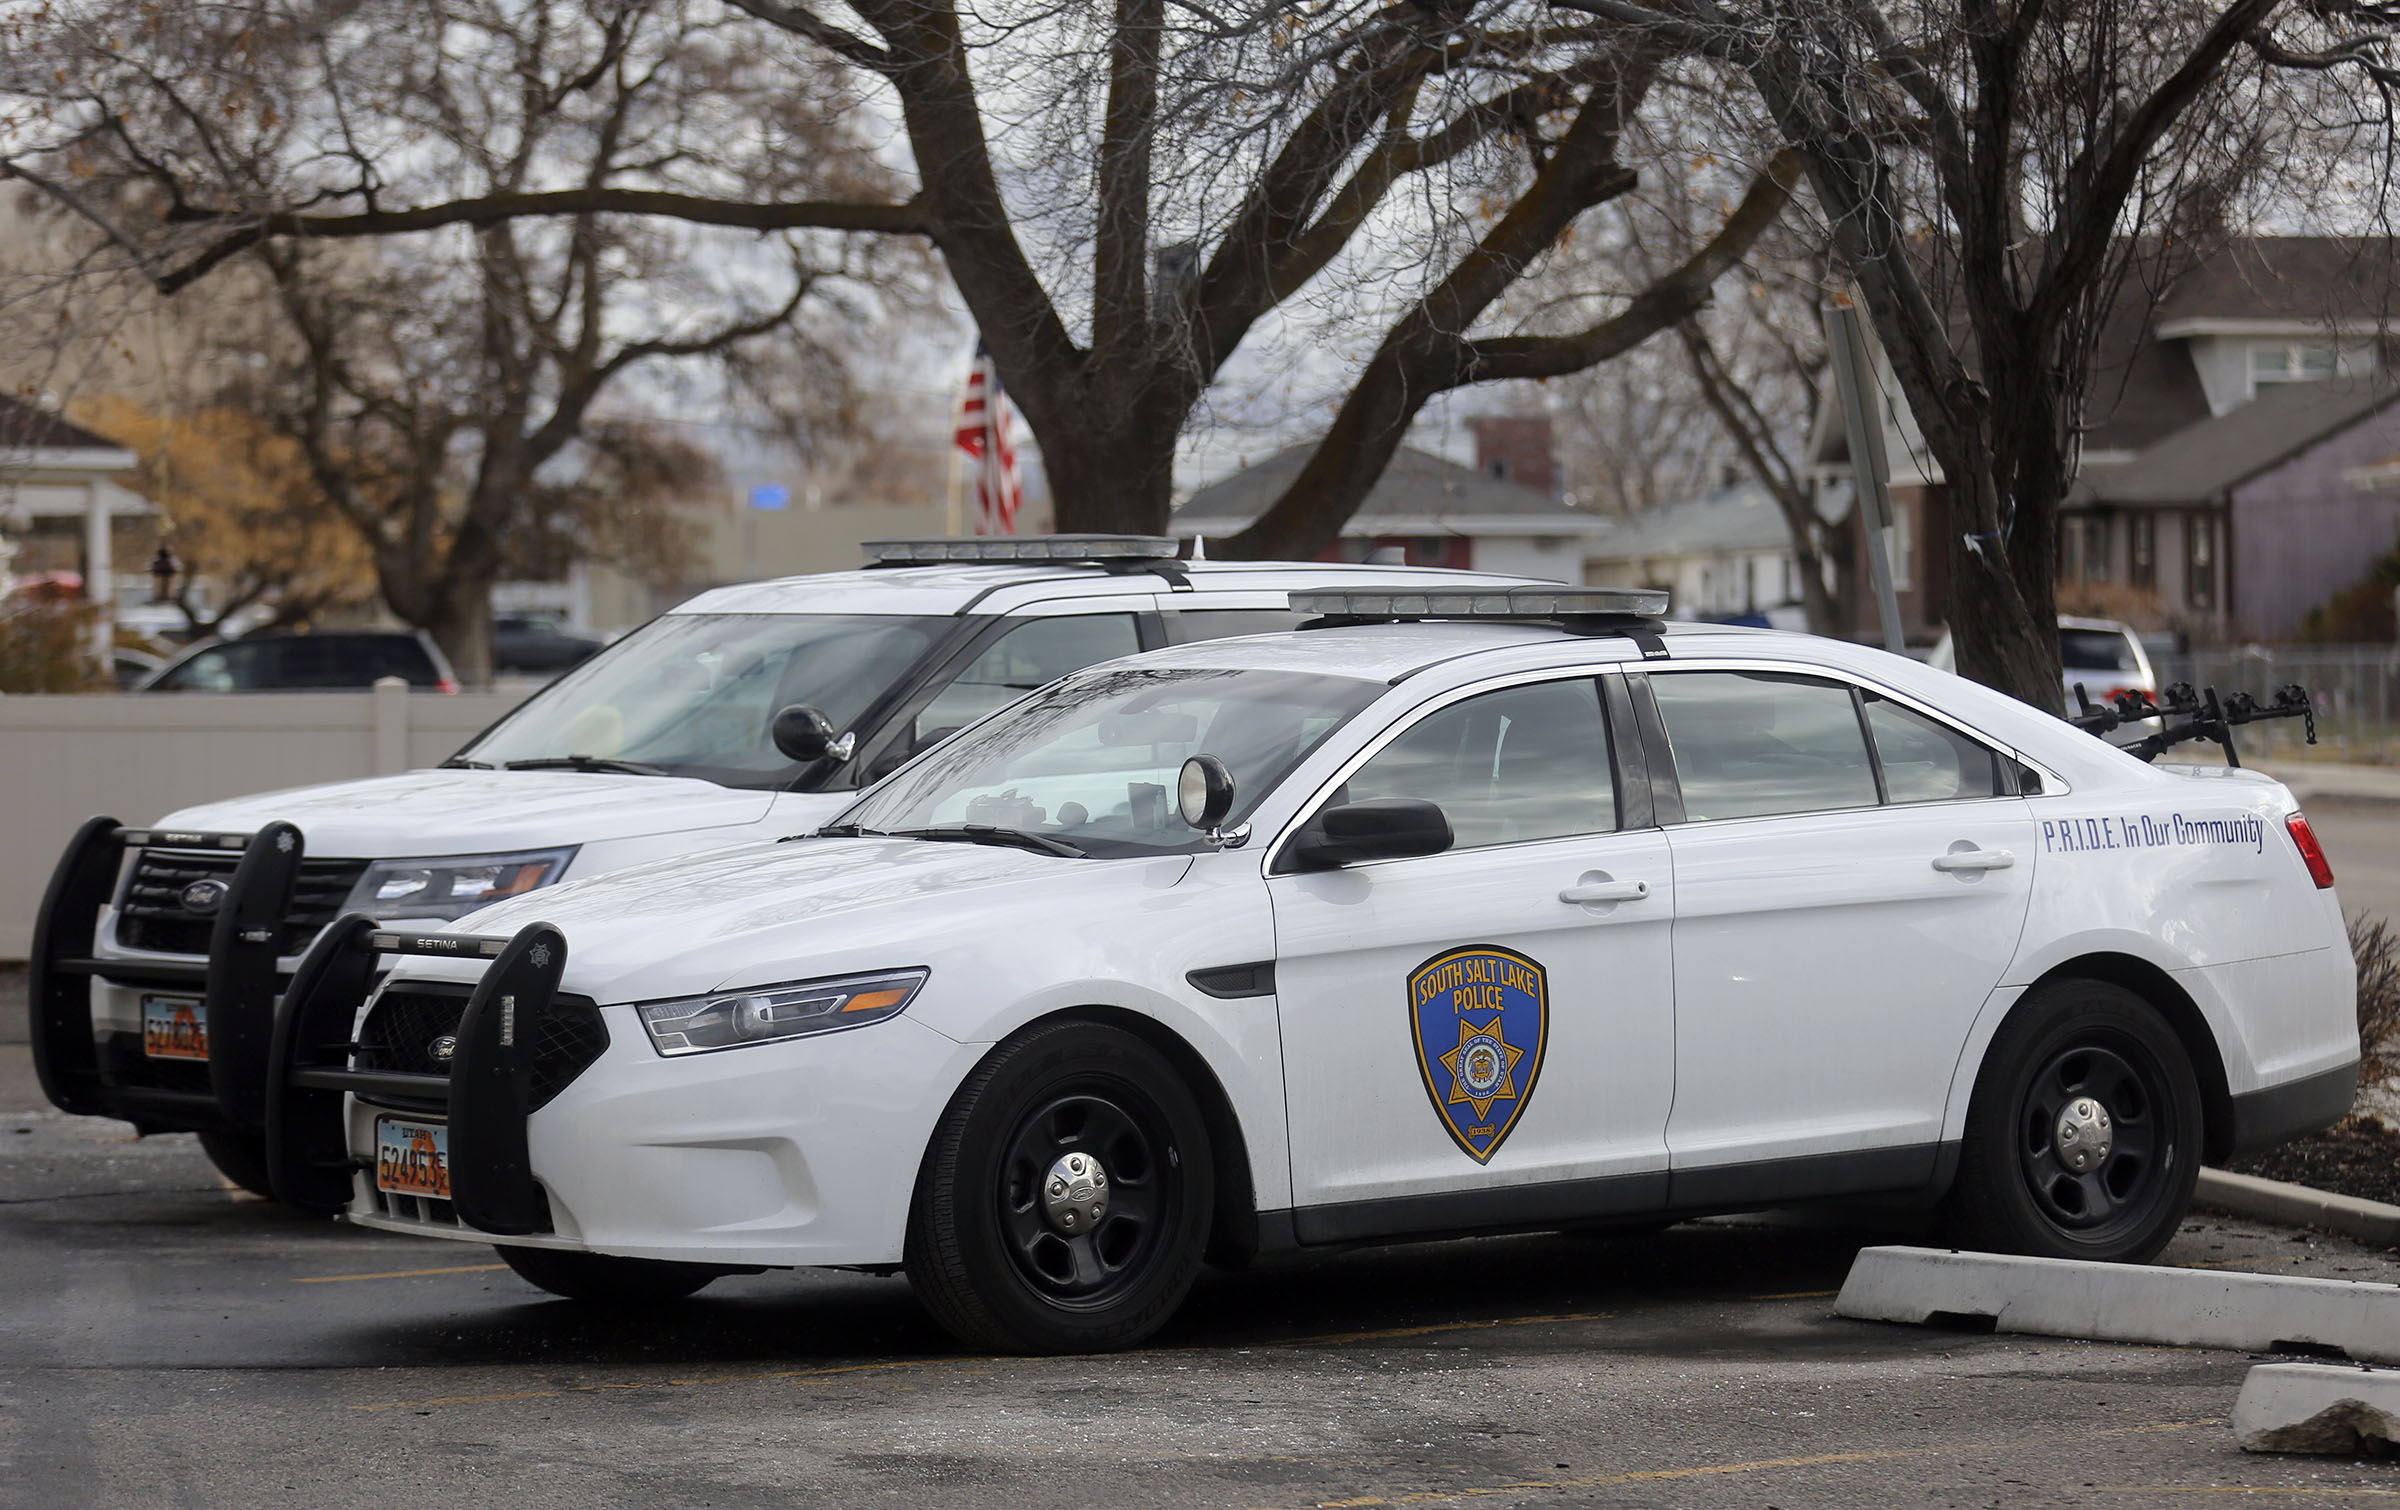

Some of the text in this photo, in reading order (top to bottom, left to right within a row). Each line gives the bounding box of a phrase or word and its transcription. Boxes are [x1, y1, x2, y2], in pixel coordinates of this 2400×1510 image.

[2042, 813, 2264, 854] P.R.I.D.E. In Our Community
[416, 938, 458, 950] SETINA
[1420, 959, 1536, 1006] SOUTH SALT LAKE
[1453, 984, 1505, 1015] POLICE
[402, 1127, 427, 1140] UTAH
[382, 1146, 437, 1187] 524953
